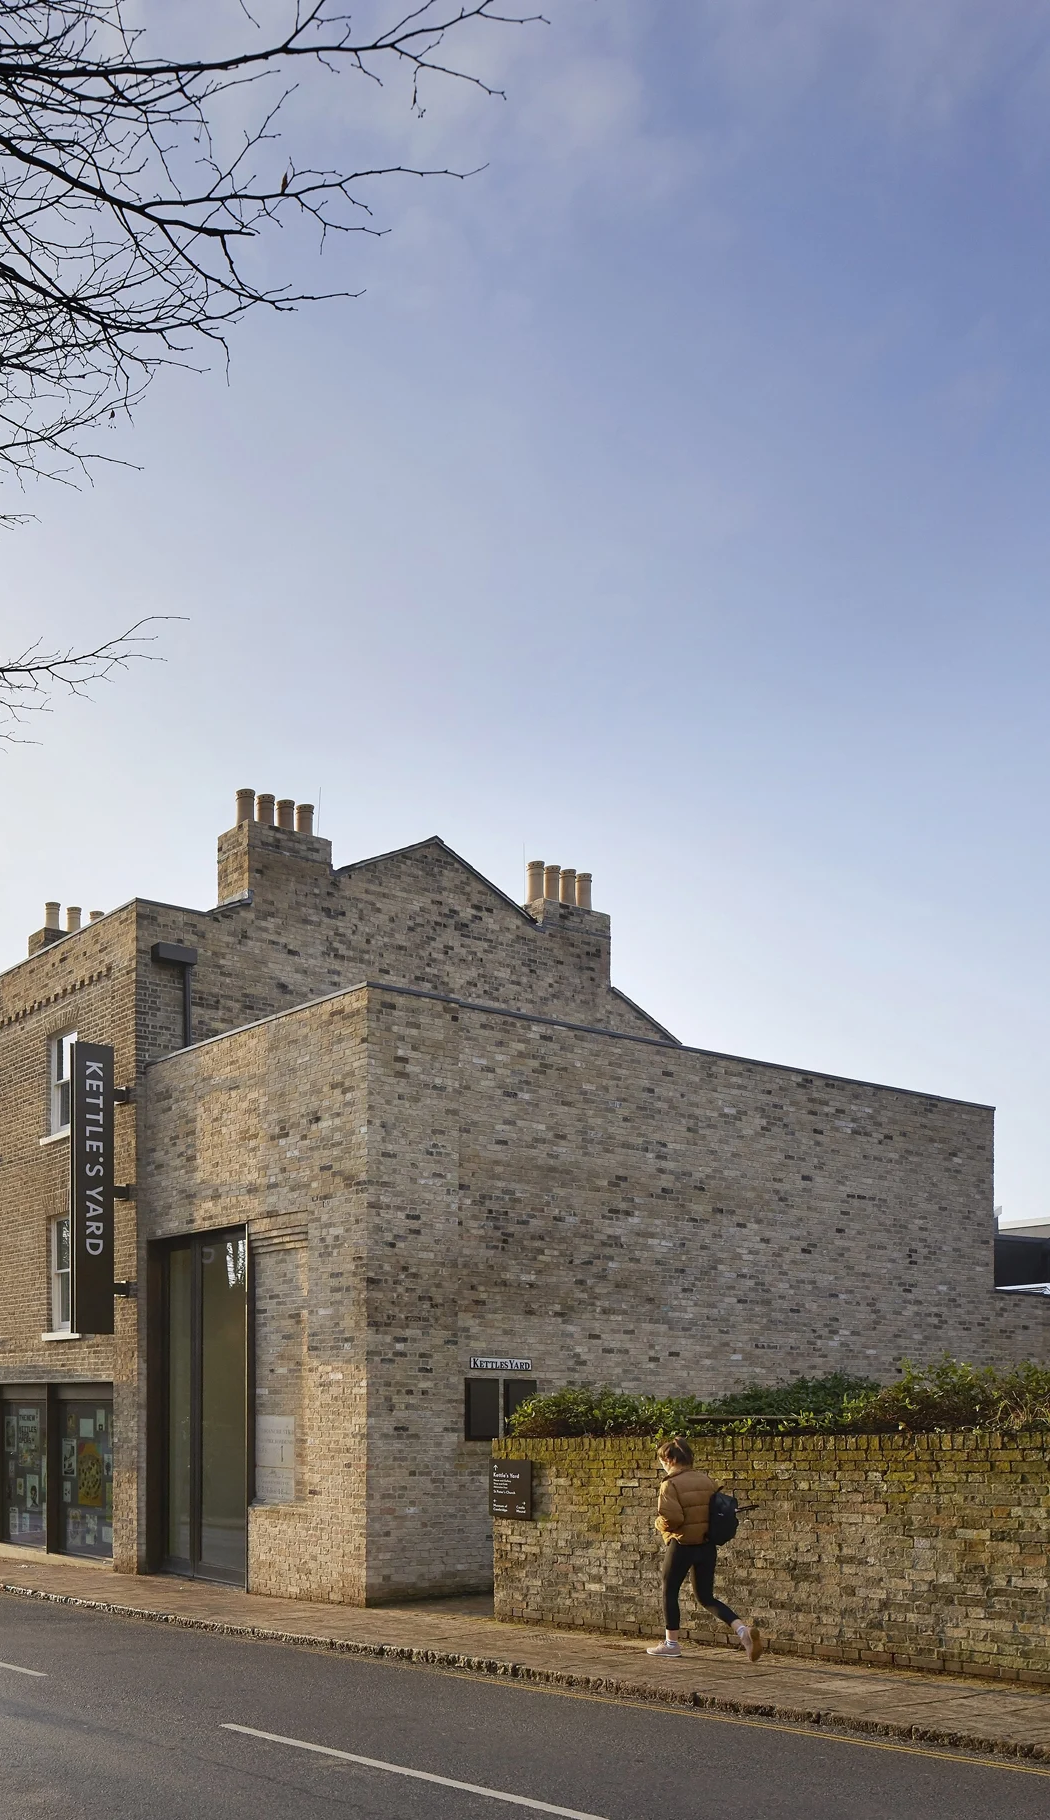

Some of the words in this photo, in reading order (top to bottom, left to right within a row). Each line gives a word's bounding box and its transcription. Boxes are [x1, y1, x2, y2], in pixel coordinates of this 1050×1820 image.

[84, 1061, 104, 1178] KETTLE'S
[85, 1186, 104, 1256] YARD
[510, 1360, 530, 1370] YARD
